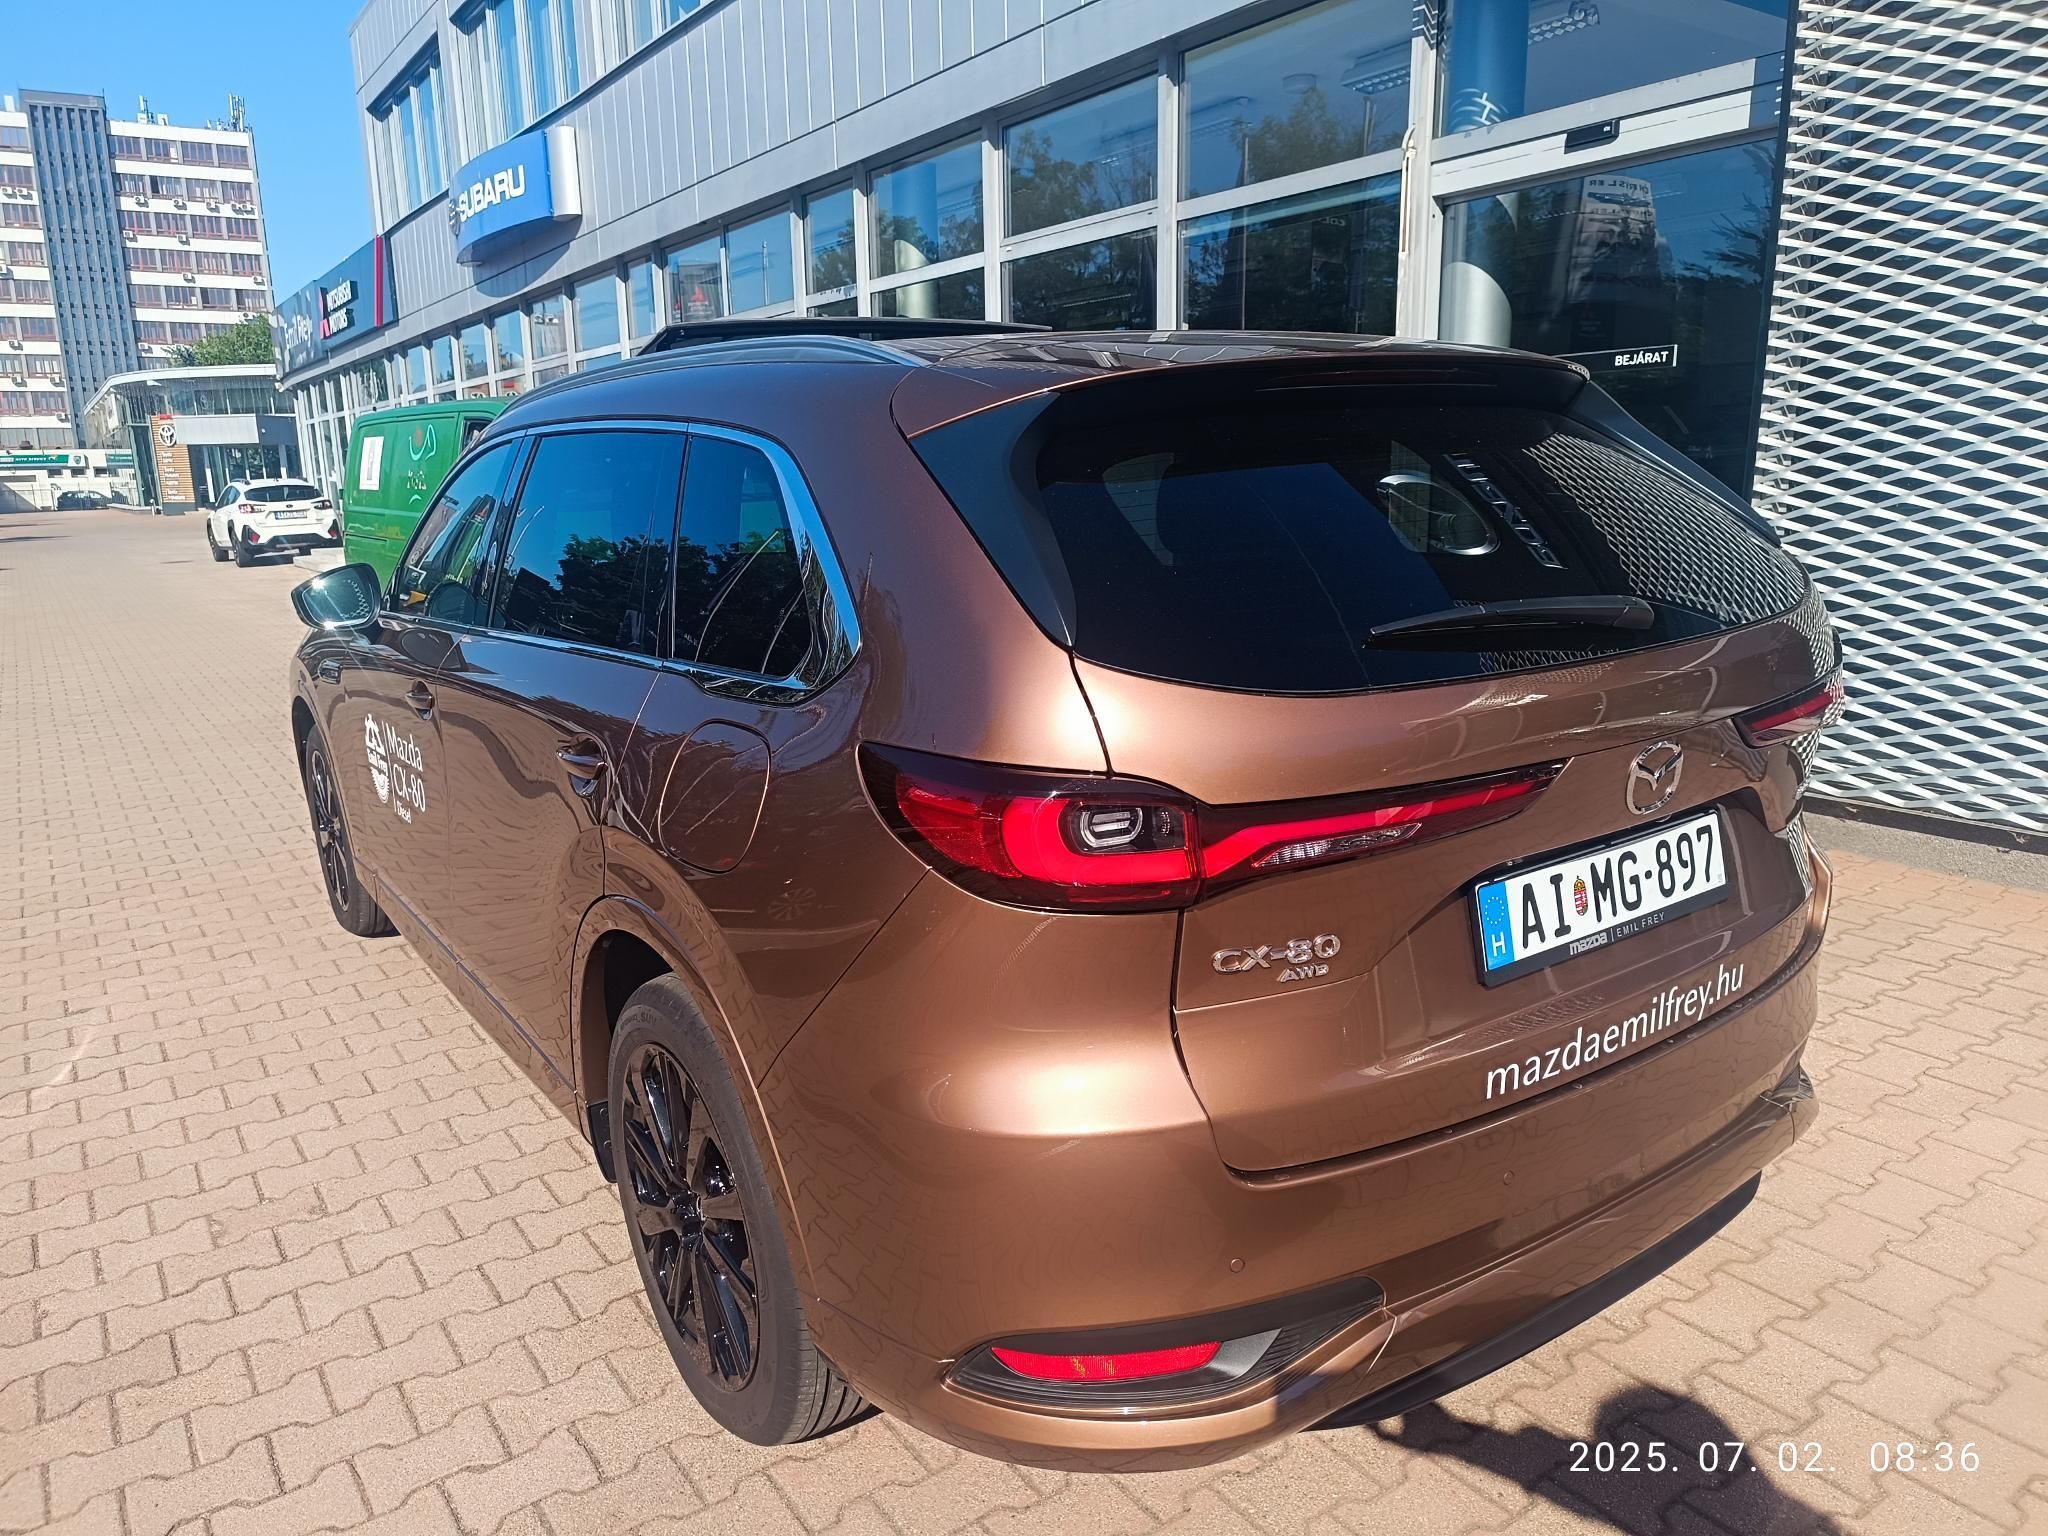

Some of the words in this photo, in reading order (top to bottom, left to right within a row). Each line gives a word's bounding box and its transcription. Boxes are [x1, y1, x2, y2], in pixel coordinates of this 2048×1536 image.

[458, 164, 526, 223] SUBARU
[1614, 350, 1669, 367] BEJÁRAT
[386, 722, 424, 773] Mazda
[393, 763, 426, 813] CX-80
[1521, 873, 1572, 950] AI
[1589, 825, 1716, 922] MG-897
[1491, 931, 1506, 957] H
[1616, 924, 1640, 938] EMIL
[1641, 912, 1665, 929] FREY
[1212, 932, 1342, 976] CX-80
[1276, 962, 1330, 983] AWD
[1486, 961, 1746, 1100] mazdaemilfrey.hu
